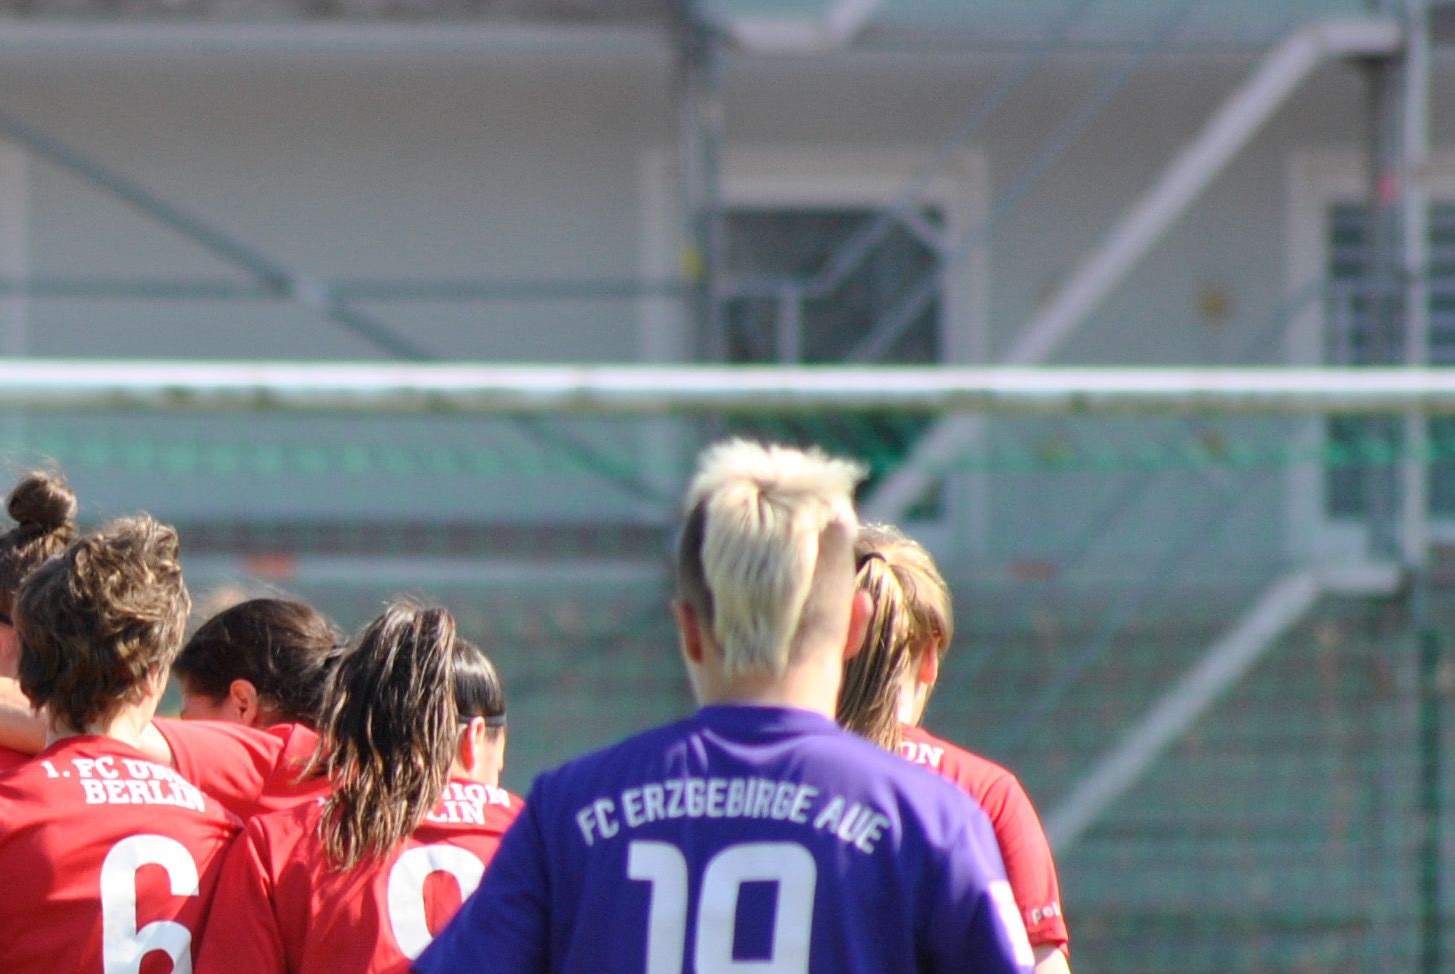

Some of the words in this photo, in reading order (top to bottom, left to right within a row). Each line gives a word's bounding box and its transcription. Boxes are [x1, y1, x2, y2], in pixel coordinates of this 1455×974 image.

[72, 756, 119, 779] FC
[576, 797, 620, 846] FC
[621, 778, 819, 828] ERZGEBIRGE
[813, 795, 891, 854] AUE
